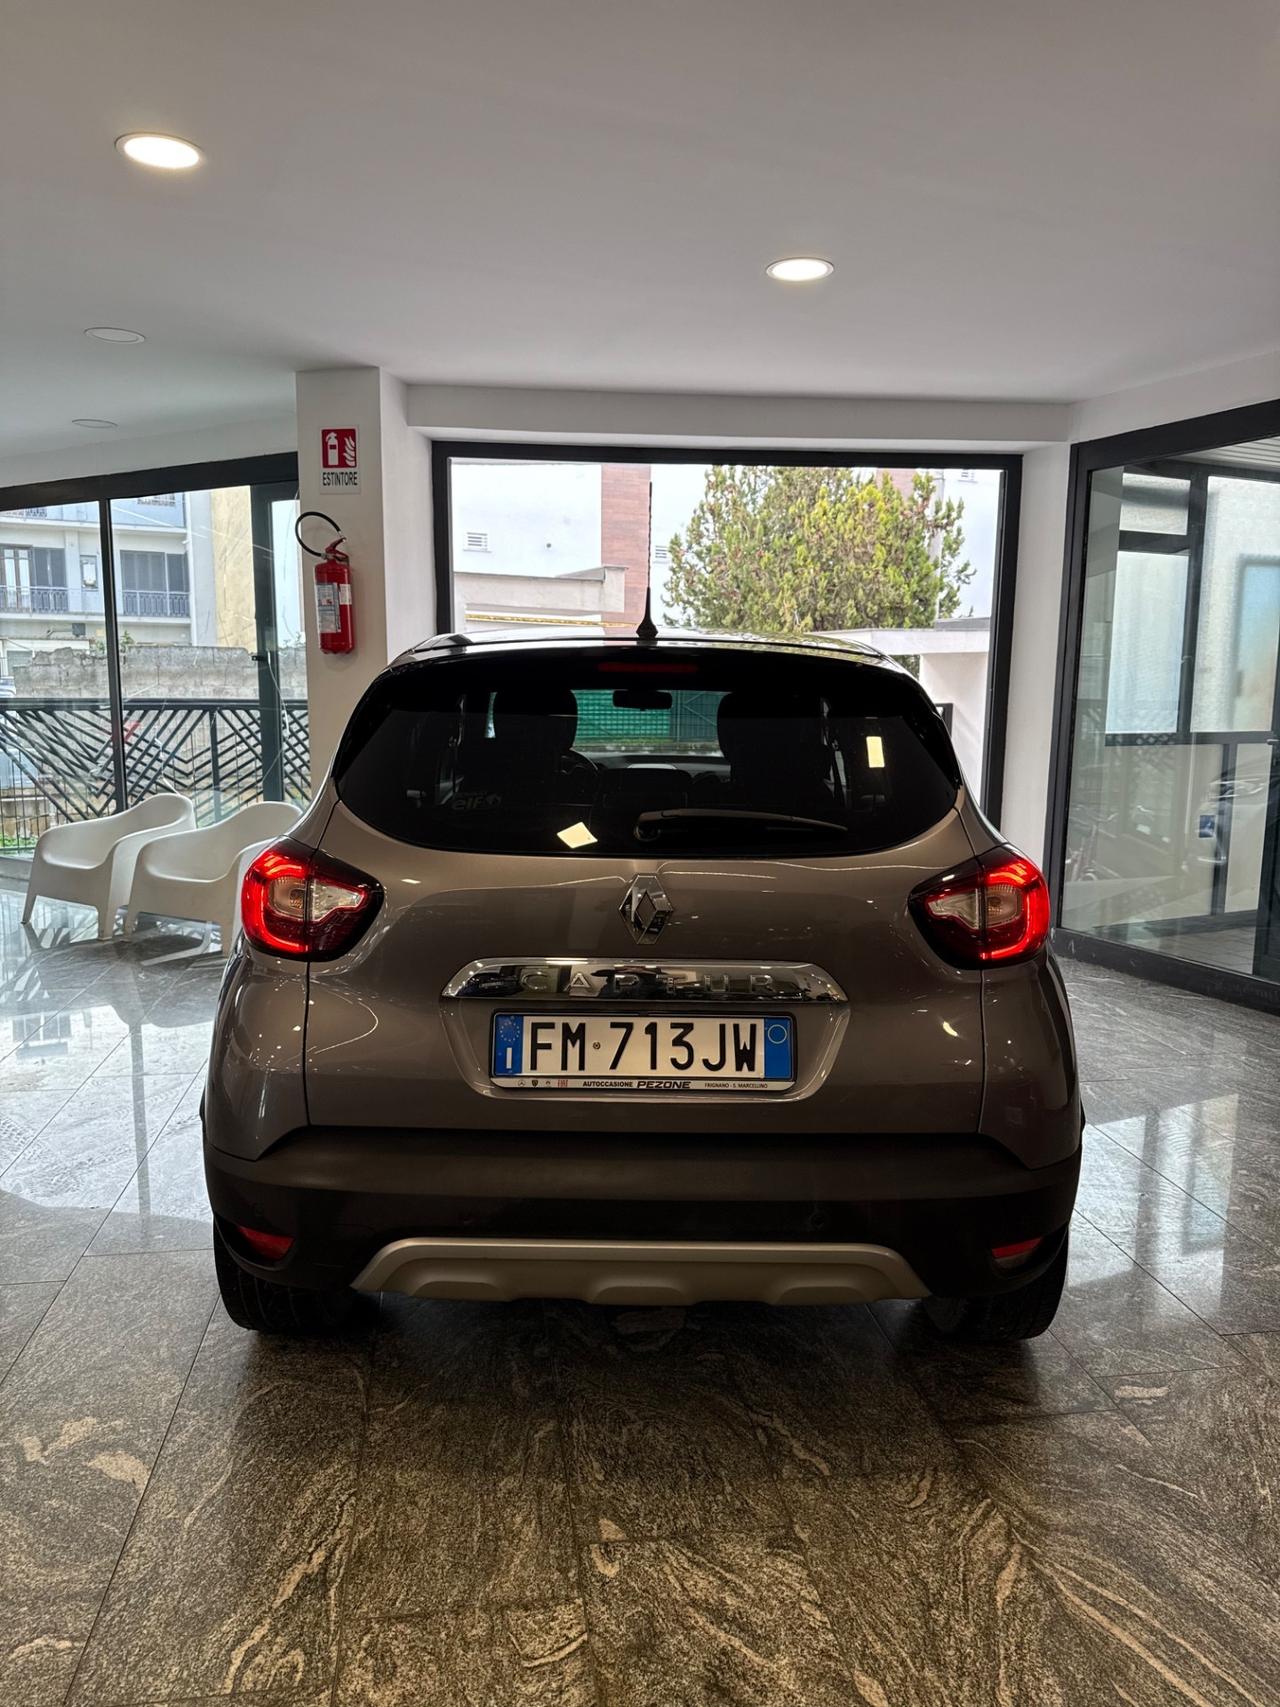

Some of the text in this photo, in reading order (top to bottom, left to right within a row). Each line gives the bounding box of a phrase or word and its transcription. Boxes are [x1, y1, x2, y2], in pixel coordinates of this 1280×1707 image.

[322, 471, 358, 486] ESTINTORE
[520, 971, 776, 994] CAPTUR
[637, 1081, 691, 1089] PEZONE
